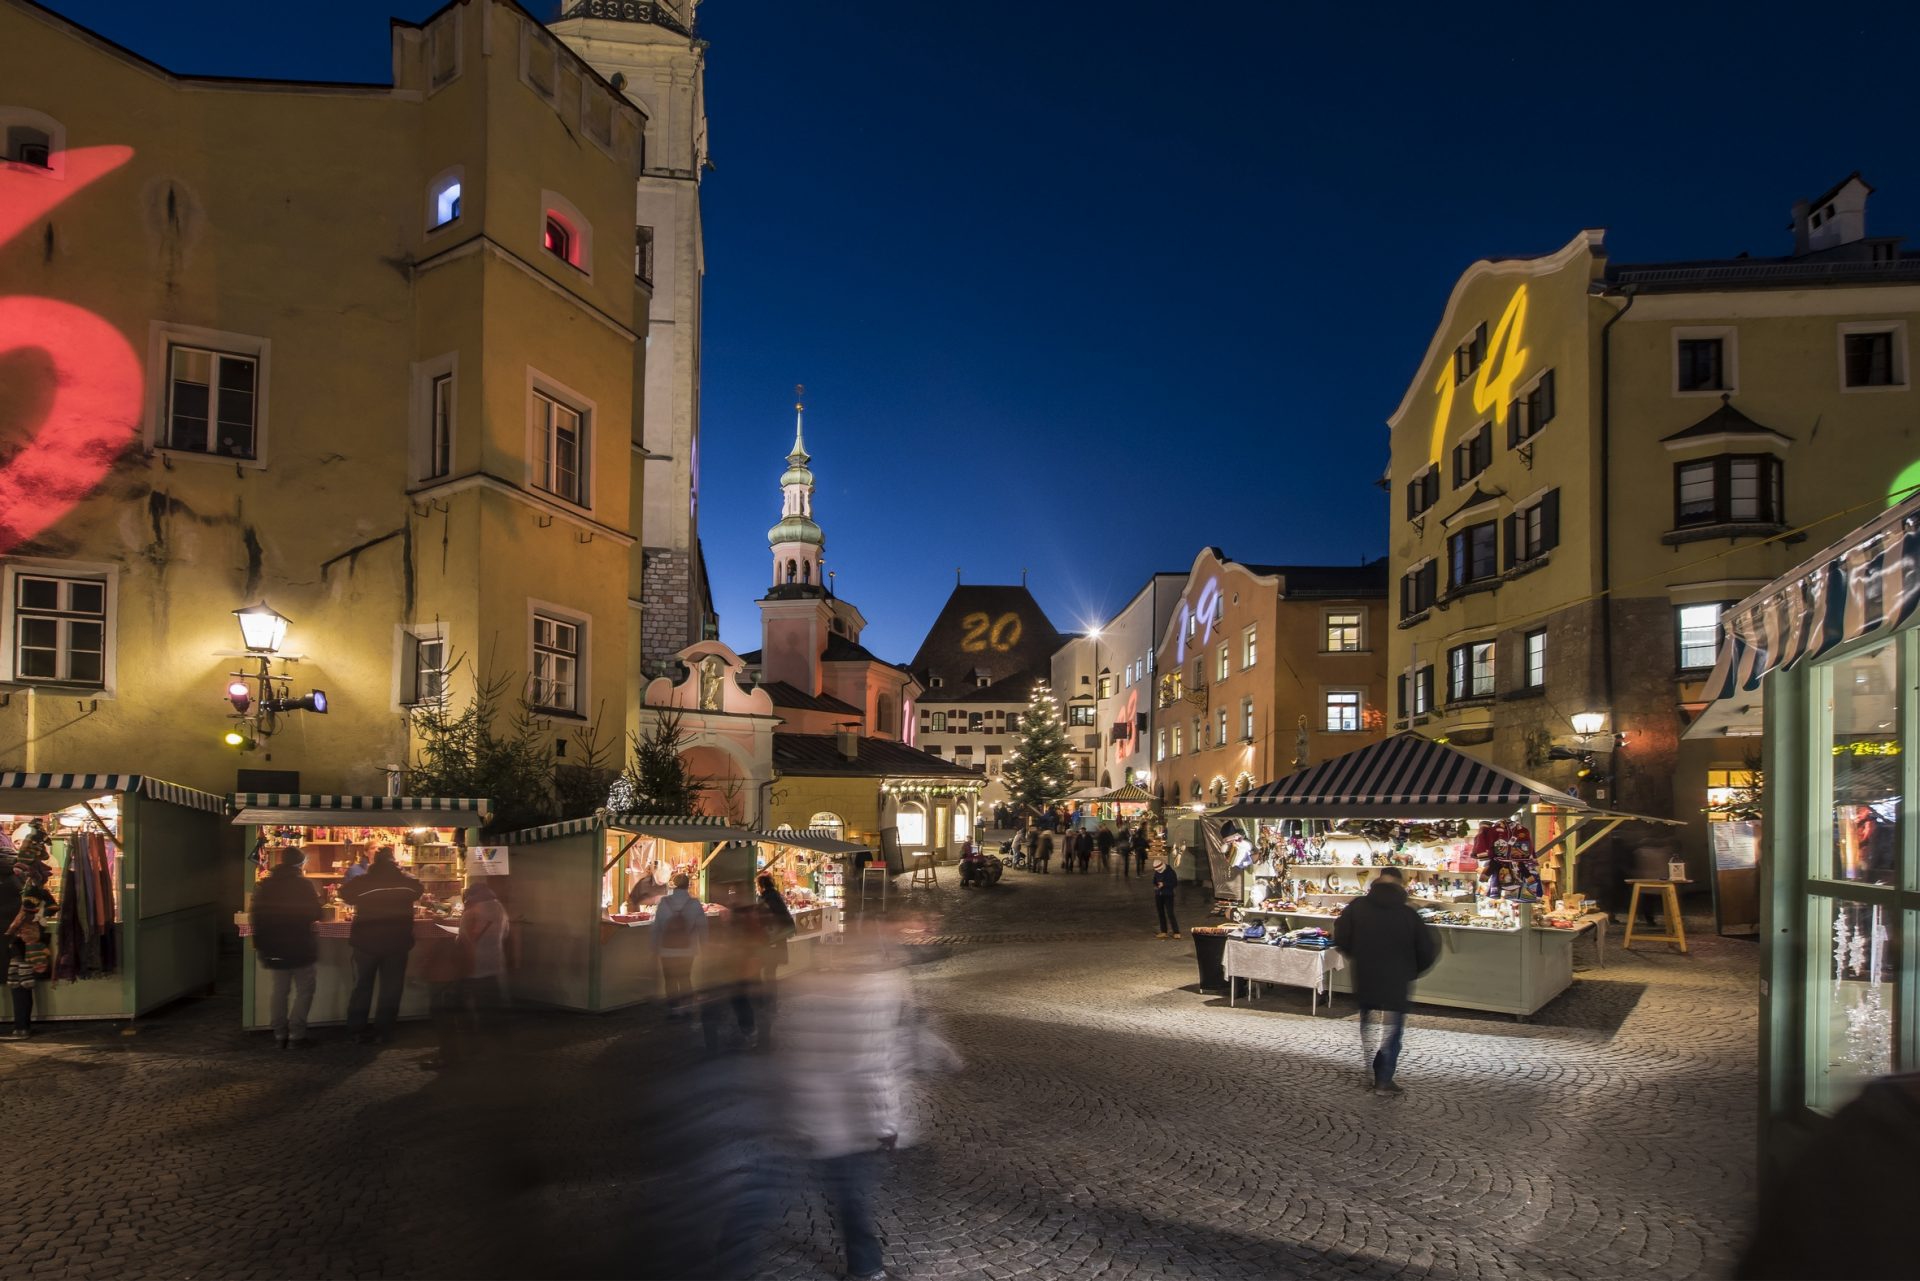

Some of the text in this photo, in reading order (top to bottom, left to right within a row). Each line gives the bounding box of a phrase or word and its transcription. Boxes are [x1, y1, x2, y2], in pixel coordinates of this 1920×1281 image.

[1429, 283, 1529, 471] 14
[961, 611, 1022, 653] 20
[1176, 575, 1218, 664] 19
